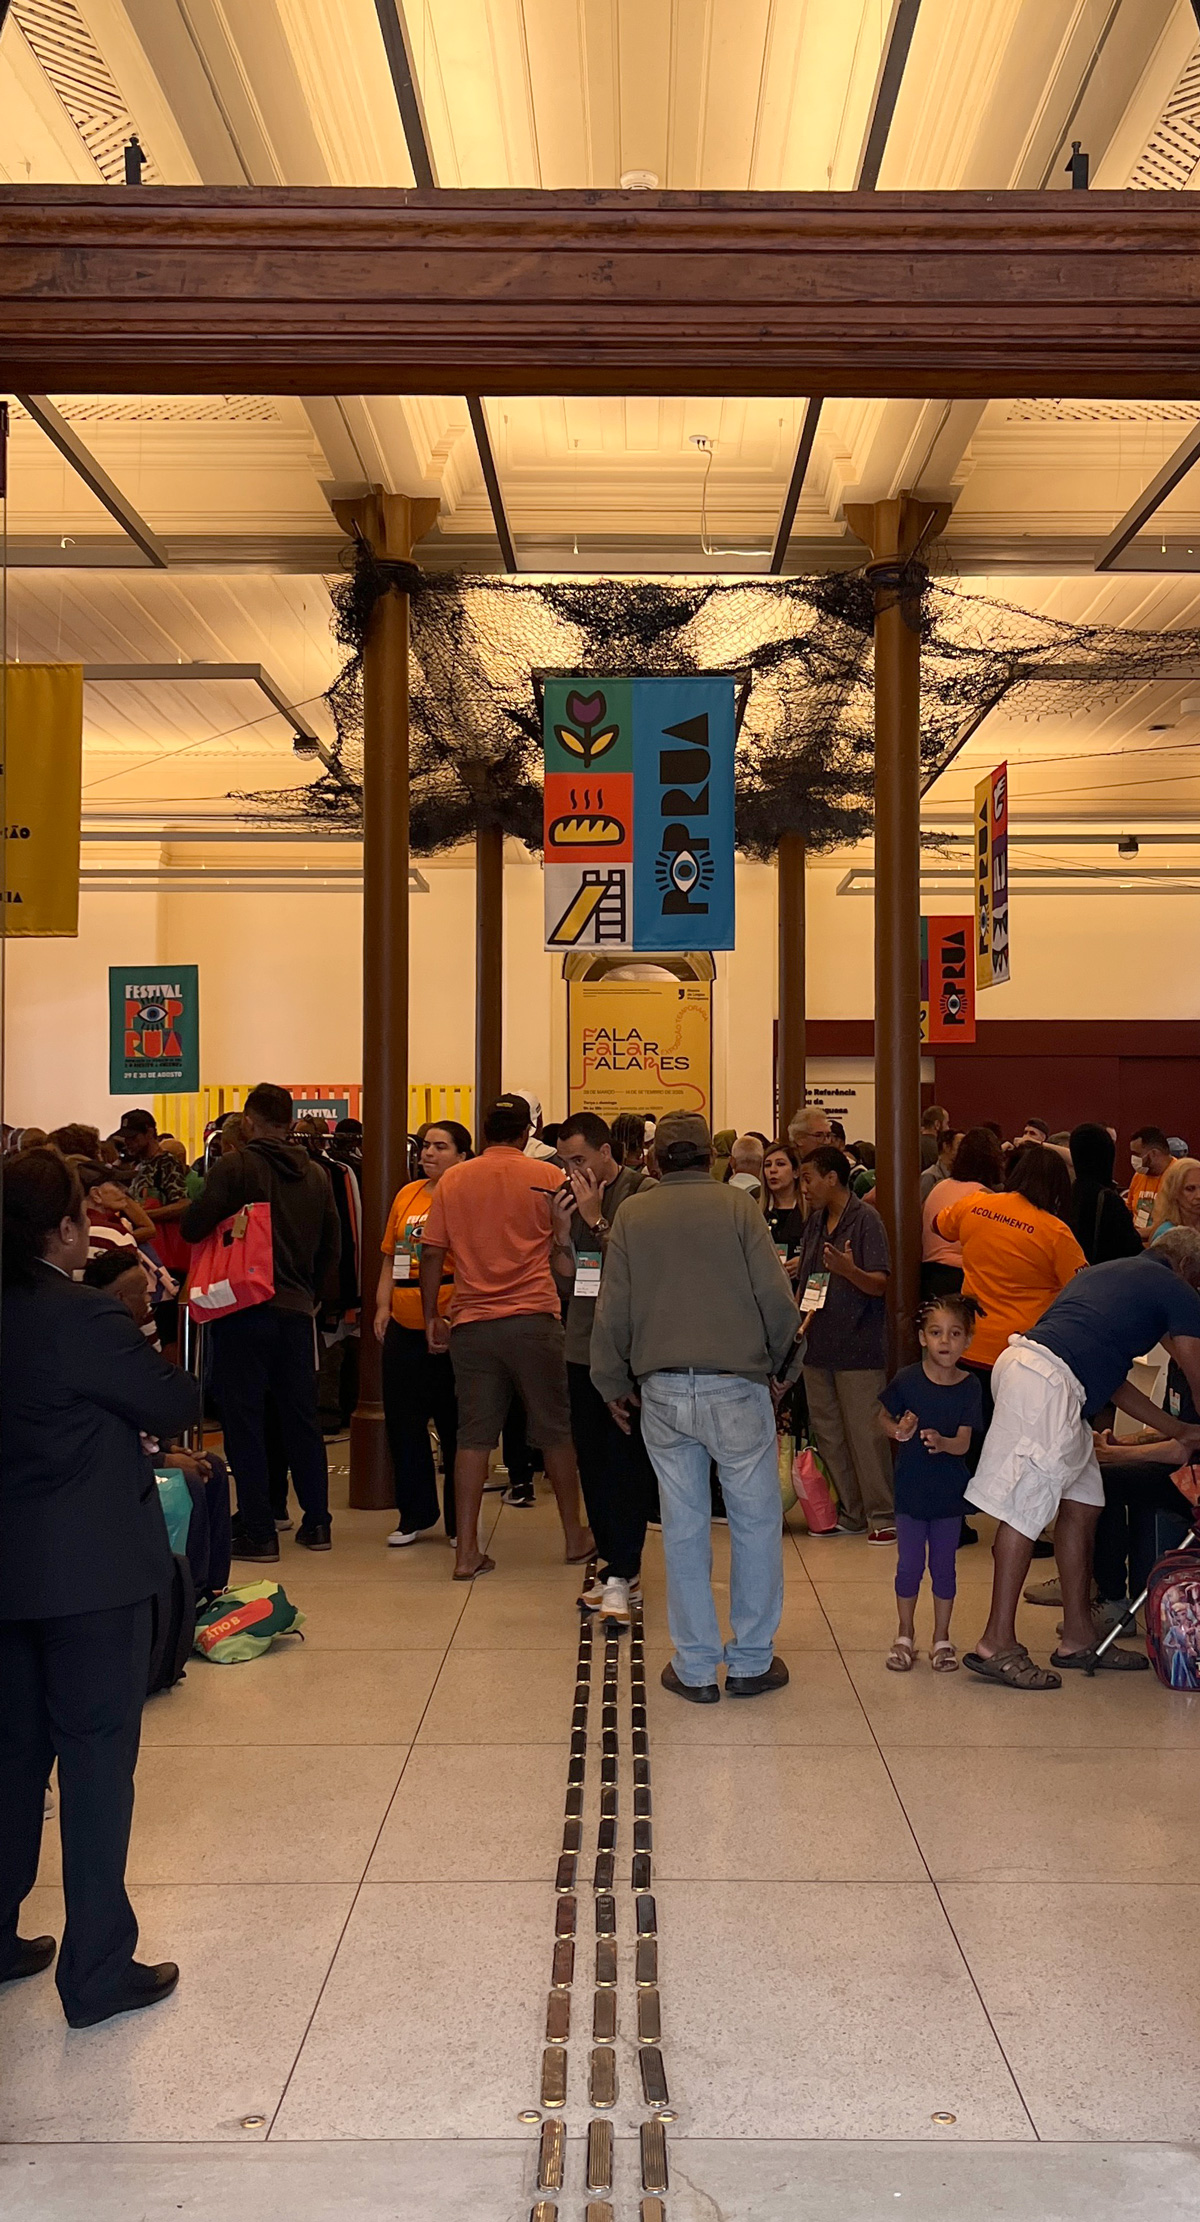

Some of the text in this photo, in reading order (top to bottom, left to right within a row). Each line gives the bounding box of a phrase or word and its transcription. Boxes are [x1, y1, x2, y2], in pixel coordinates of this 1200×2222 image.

[125, 984, 183, 998] FESTIVAL
[583, 1028, 643, 1042] FALA
[124, 1029, 183, 1058] RUA
[814, 1088, 856, 1096] Referência
[297, 1108, 338, 1119] FESTIVAL
[971, 1206, 1035, 1235] ACOLHIMENTO
[230, 1616, 241, 1626] B
